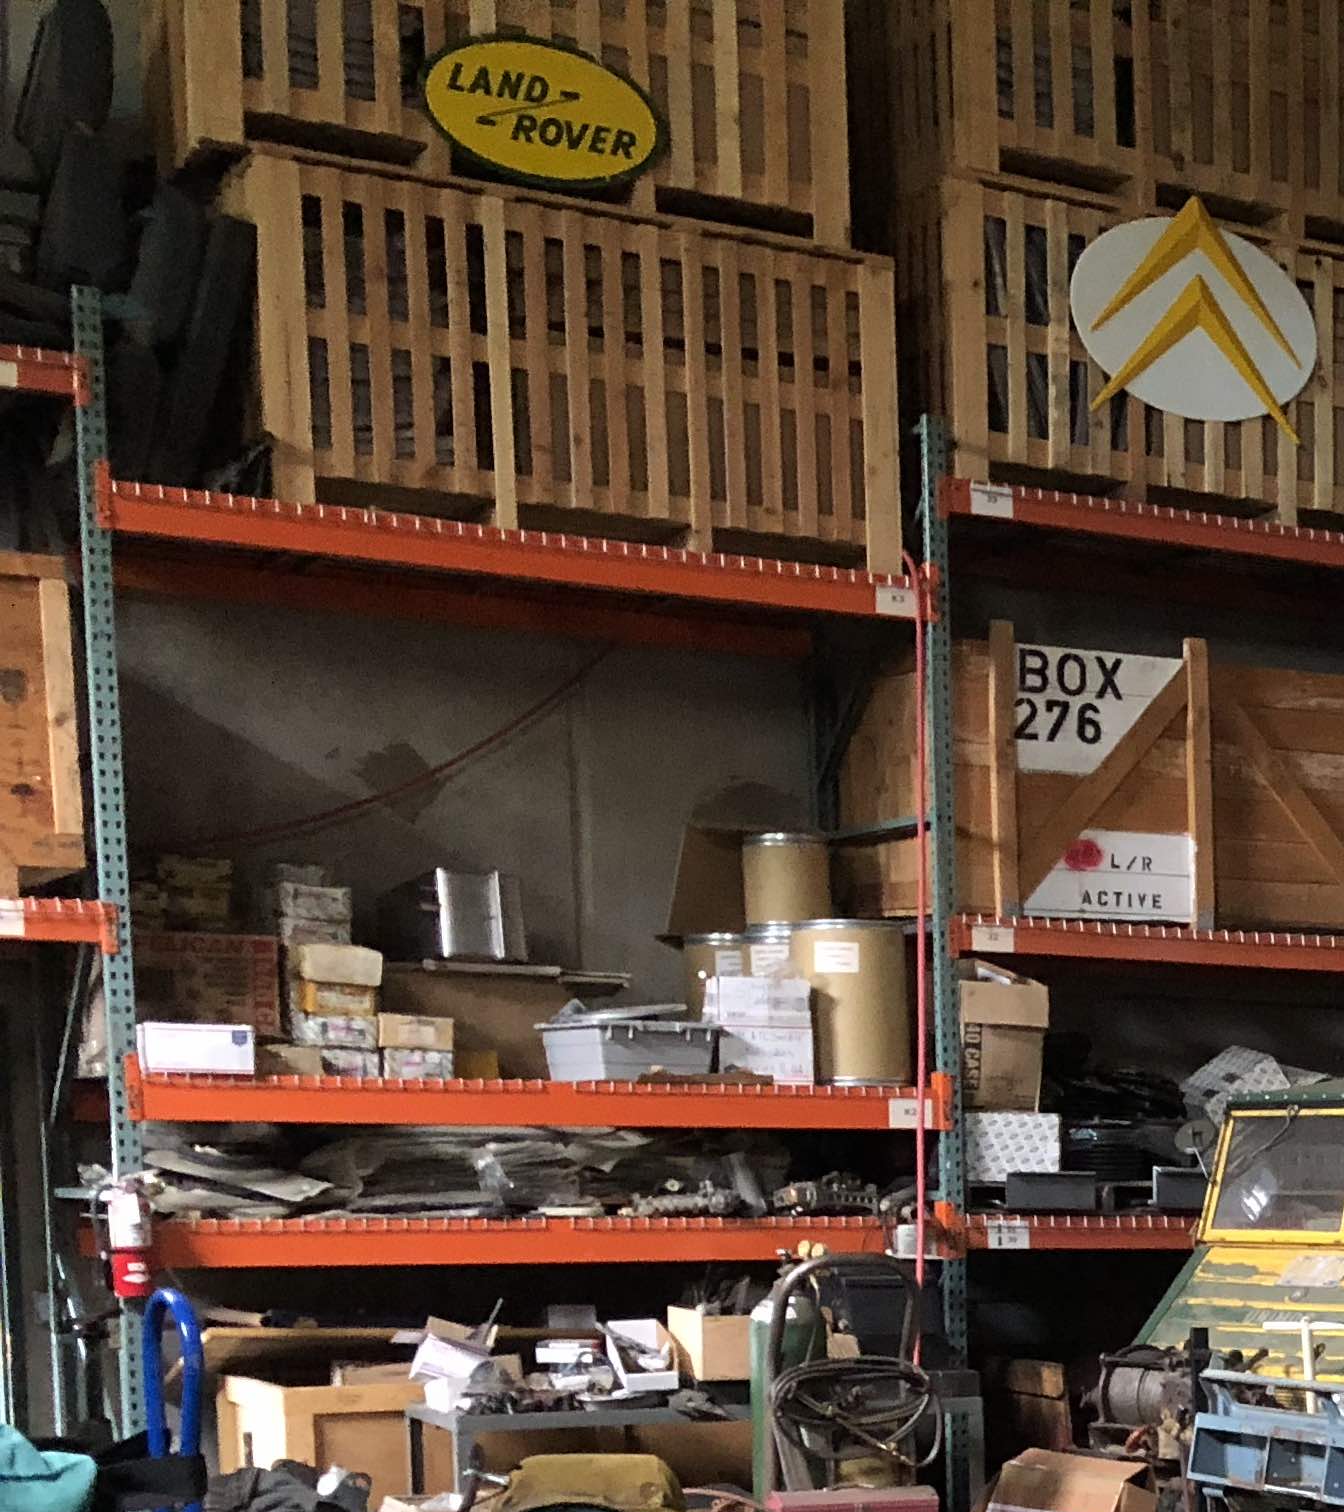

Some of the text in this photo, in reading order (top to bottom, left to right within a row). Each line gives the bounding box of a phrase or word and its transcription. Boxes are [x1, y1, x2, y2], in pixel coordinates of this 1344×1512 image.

[447, 61, 550, 104] LAND
[509, 113, 638, 160] ROVER
[1018, 647, 1123, 701] BOX
[1013, 697, 1102, 745] 276
[1110, 853, 1153, 872] L/R
[1081, 889, 1163, 910] ACTIVE
[964, 1047, 982, 1090] CASE
